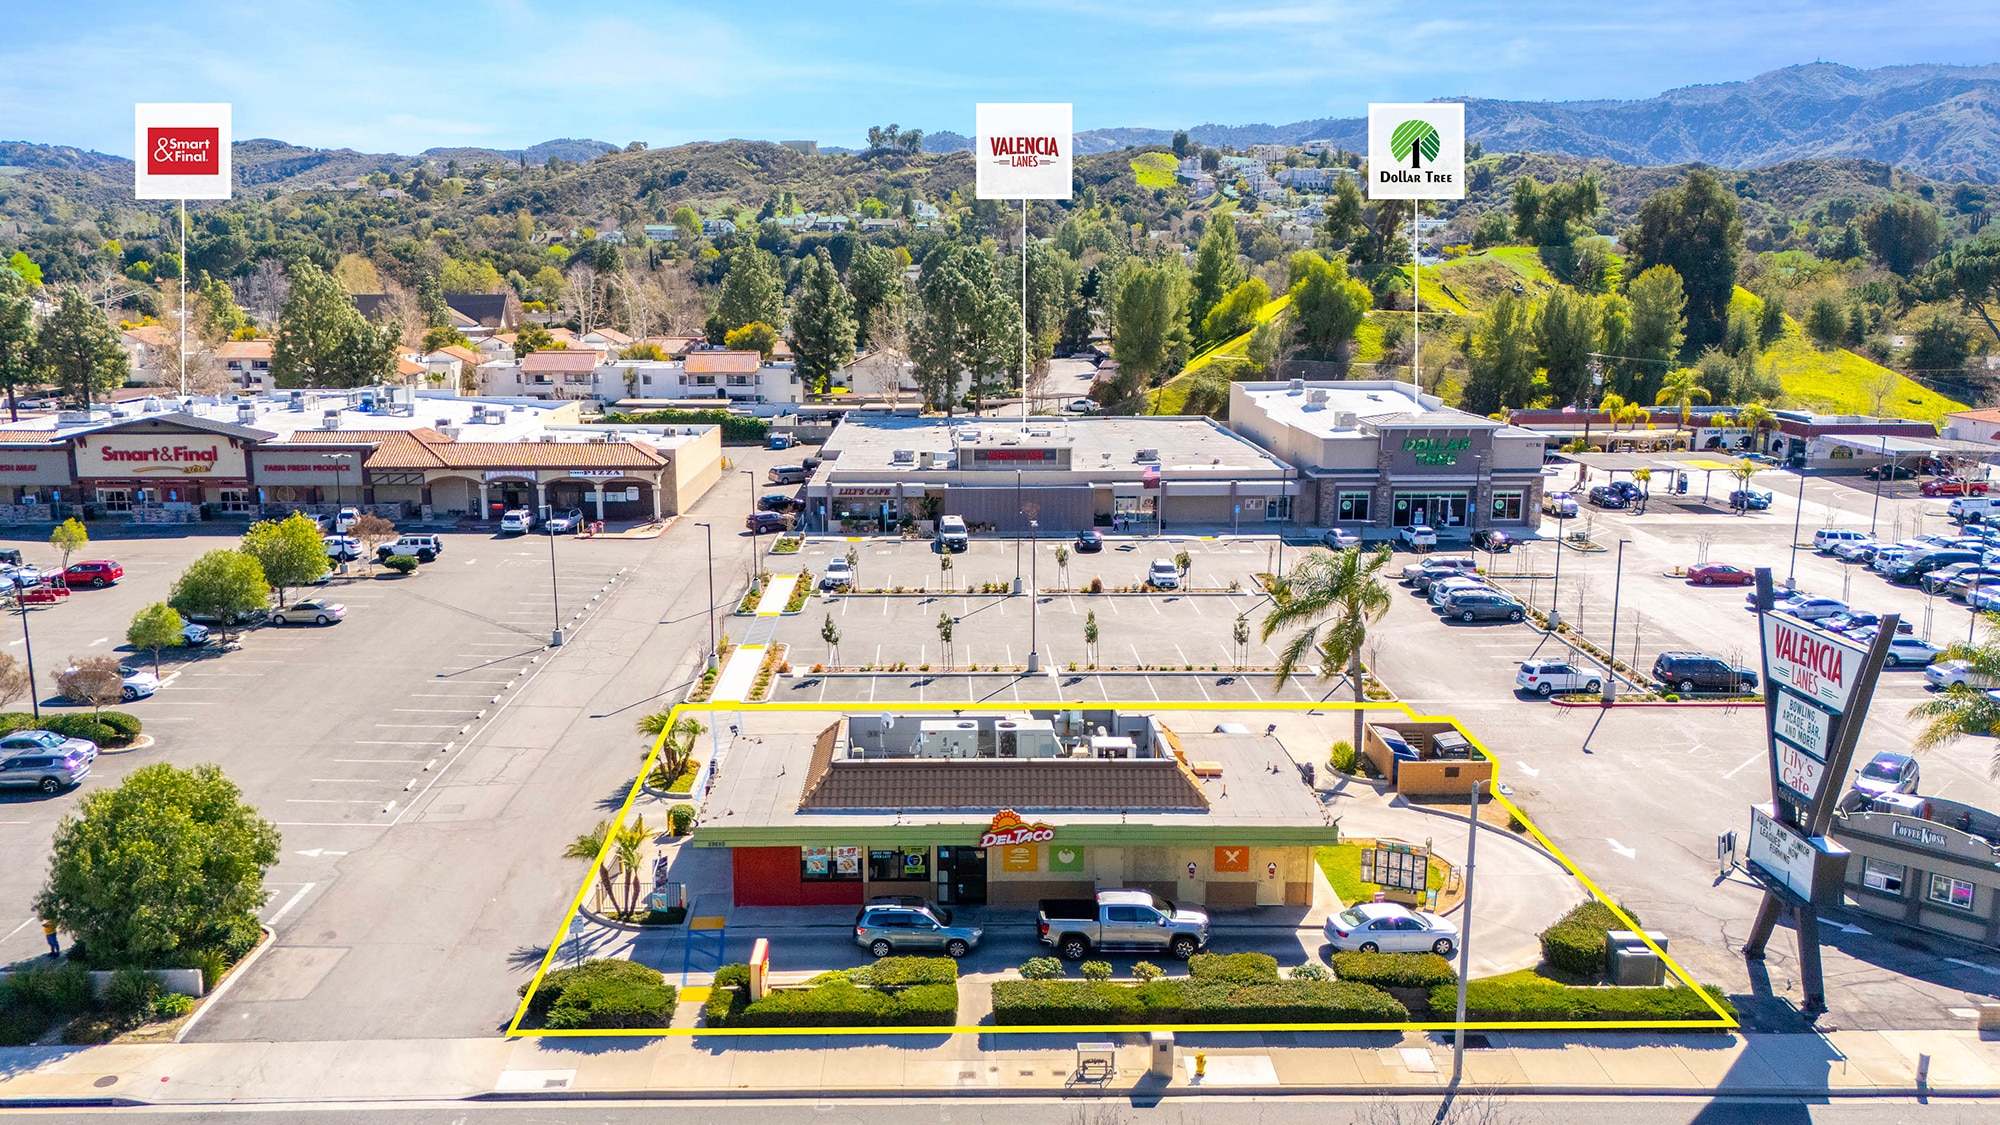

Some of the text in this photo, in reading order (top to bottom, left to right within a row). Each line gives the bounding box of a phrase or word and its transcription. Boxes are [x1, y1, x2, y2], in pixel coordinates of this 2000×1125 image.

[1402, 437, 1472, 451] DOLLAR
[1415, 452, 1457, 466] TREE
[866, 488, 892, 496] CAFE
[1775, 623, 1842, 688] VALENCIA
[1791, 664, 1818, 696] LANES
[1784, 724, 1797, 738] AND
[1783, 746, 1813, 777] Lily's
[1783, 767, 1810, 796] Cafe
[1756, 814, 1811, 858] ADULT AND JUNIOR
[1760, 827, 1800, 860] LEAGUES NOW
[1769, 843, 1791, 865] FORMING
